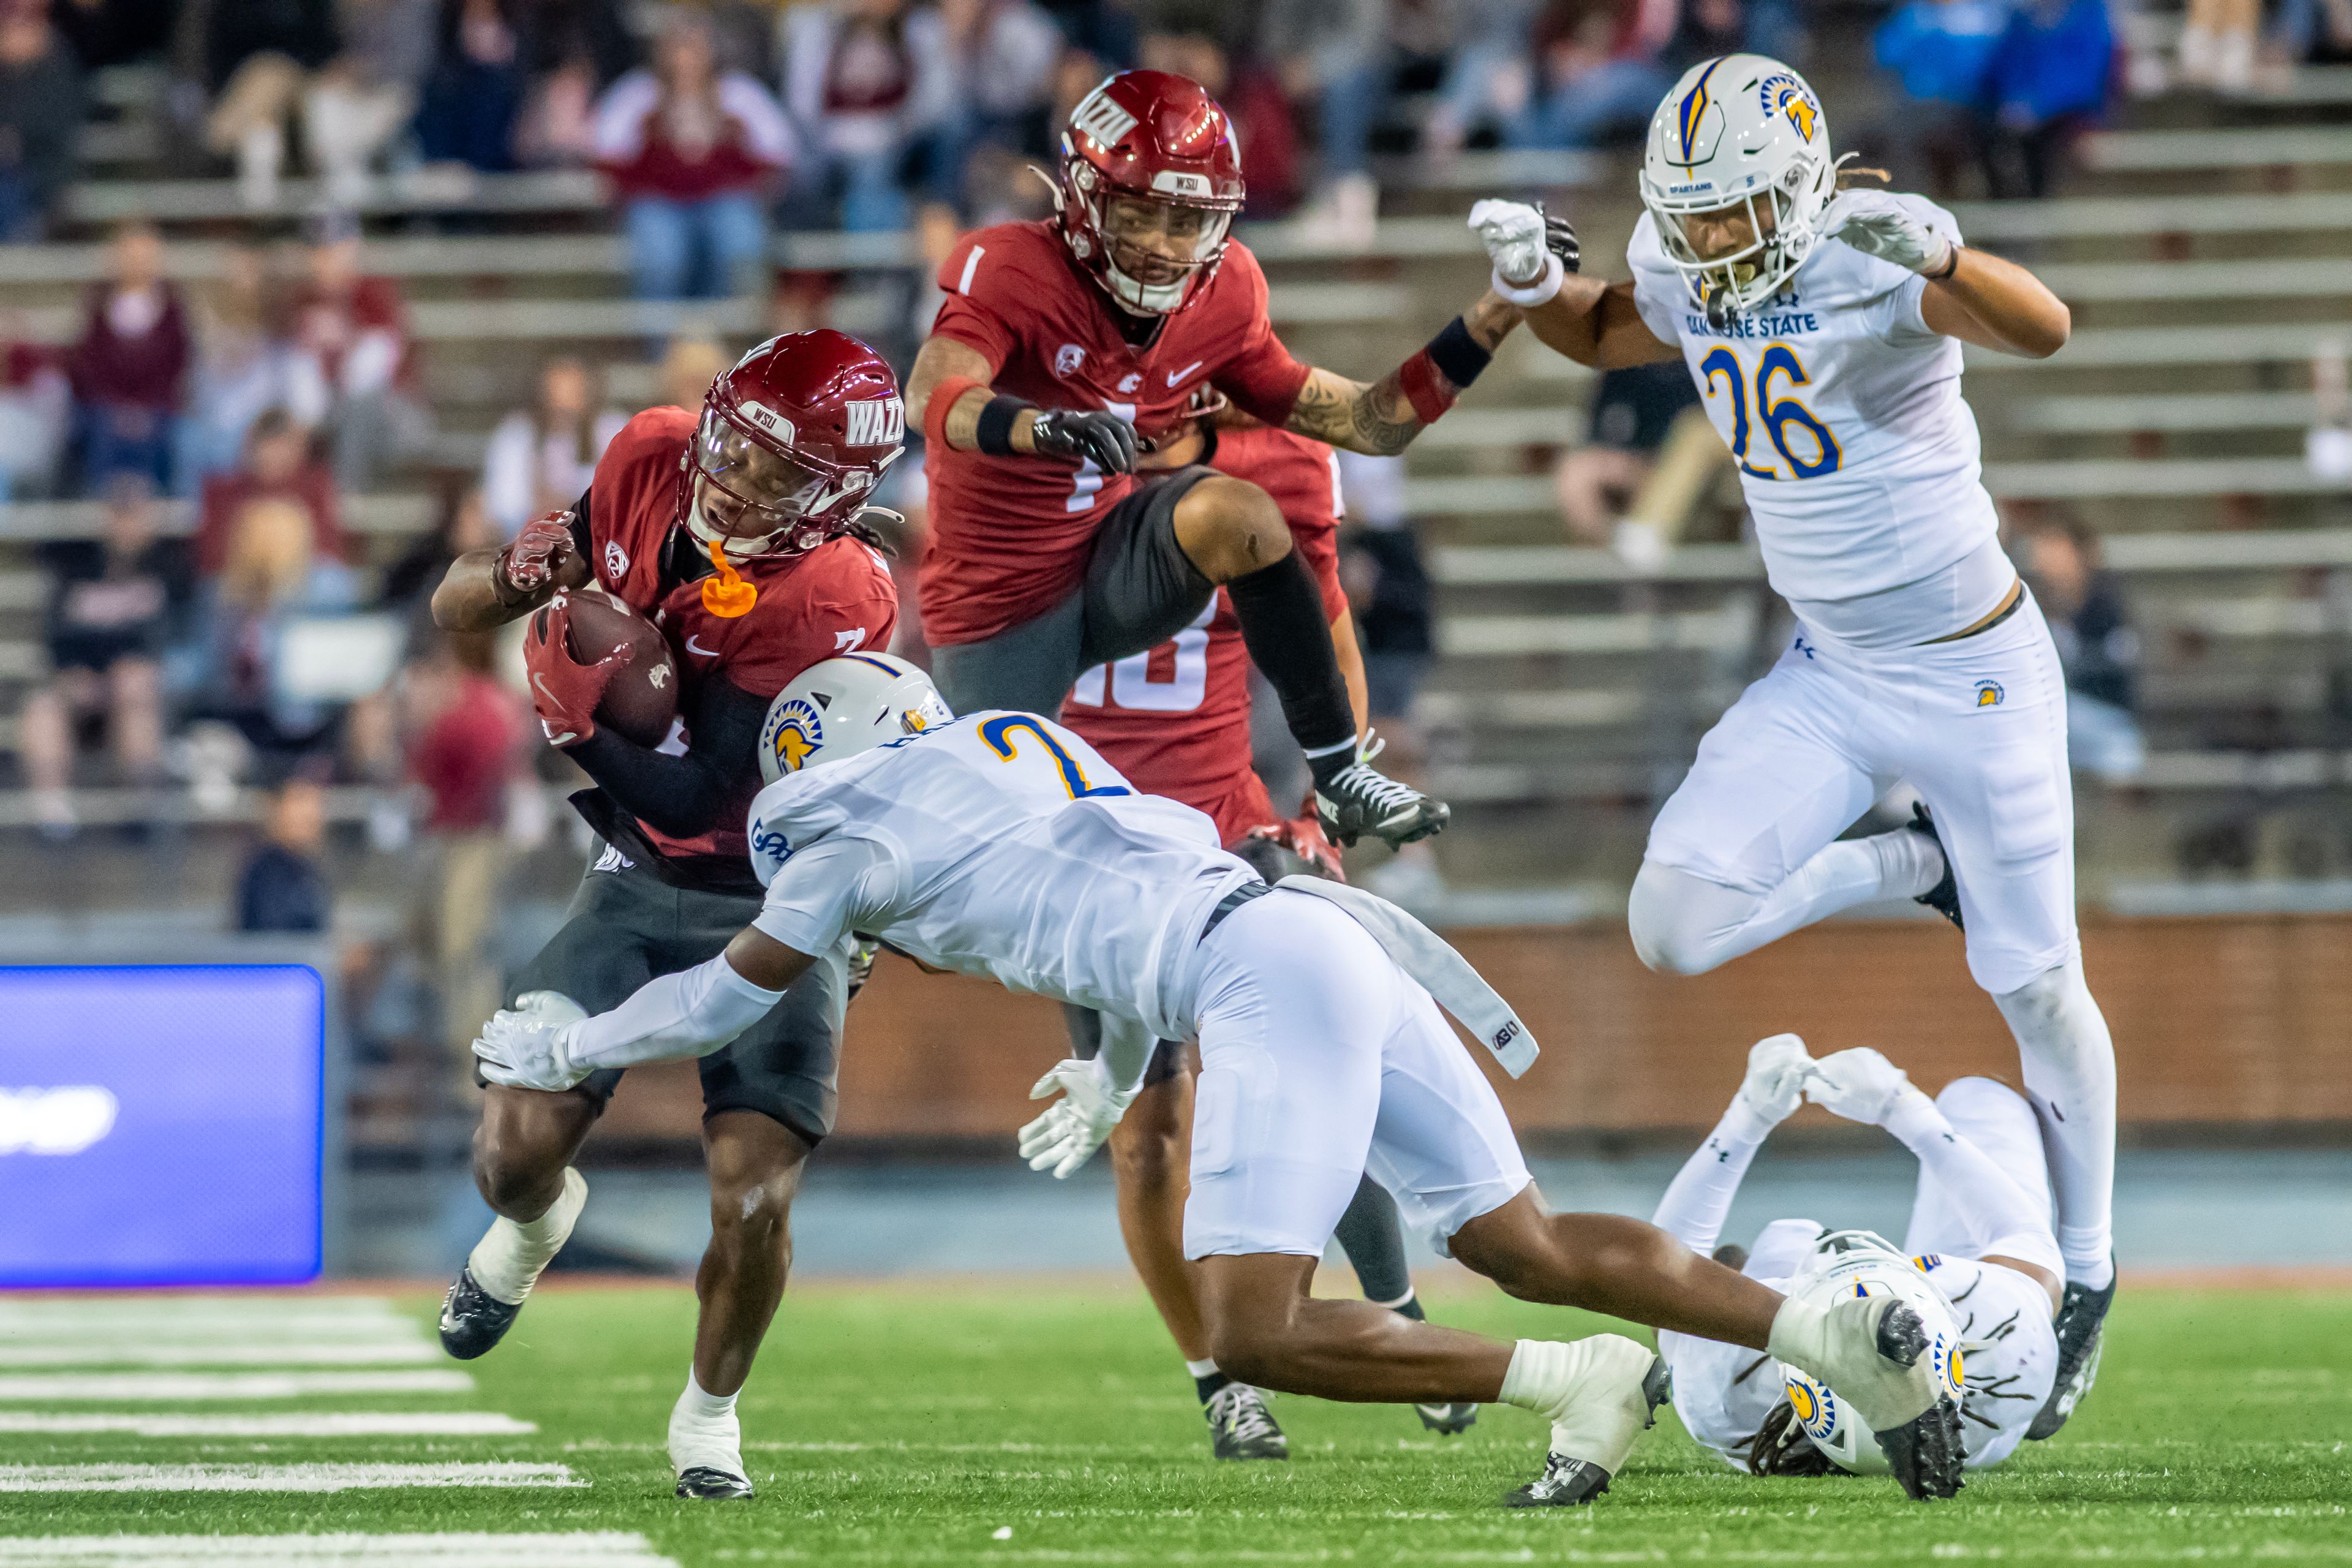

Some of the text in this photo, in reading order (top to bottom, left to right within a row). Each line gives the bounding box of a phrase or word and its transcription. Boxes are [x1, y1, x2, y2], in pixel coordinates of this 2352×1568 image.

[1176, 176, 1199, 191] WSU
[1669, 182, 1712, 194] SPARTANS
[958, 244, 986, 296] 1
[1759, 313, 1819, 337] STATE
[753, 407, 777, 430] WSU
[845, 397, 905, 447] WAZZ
[1699, 342, 1843, 481] 26
[977, 715, 1133, 801] 2
